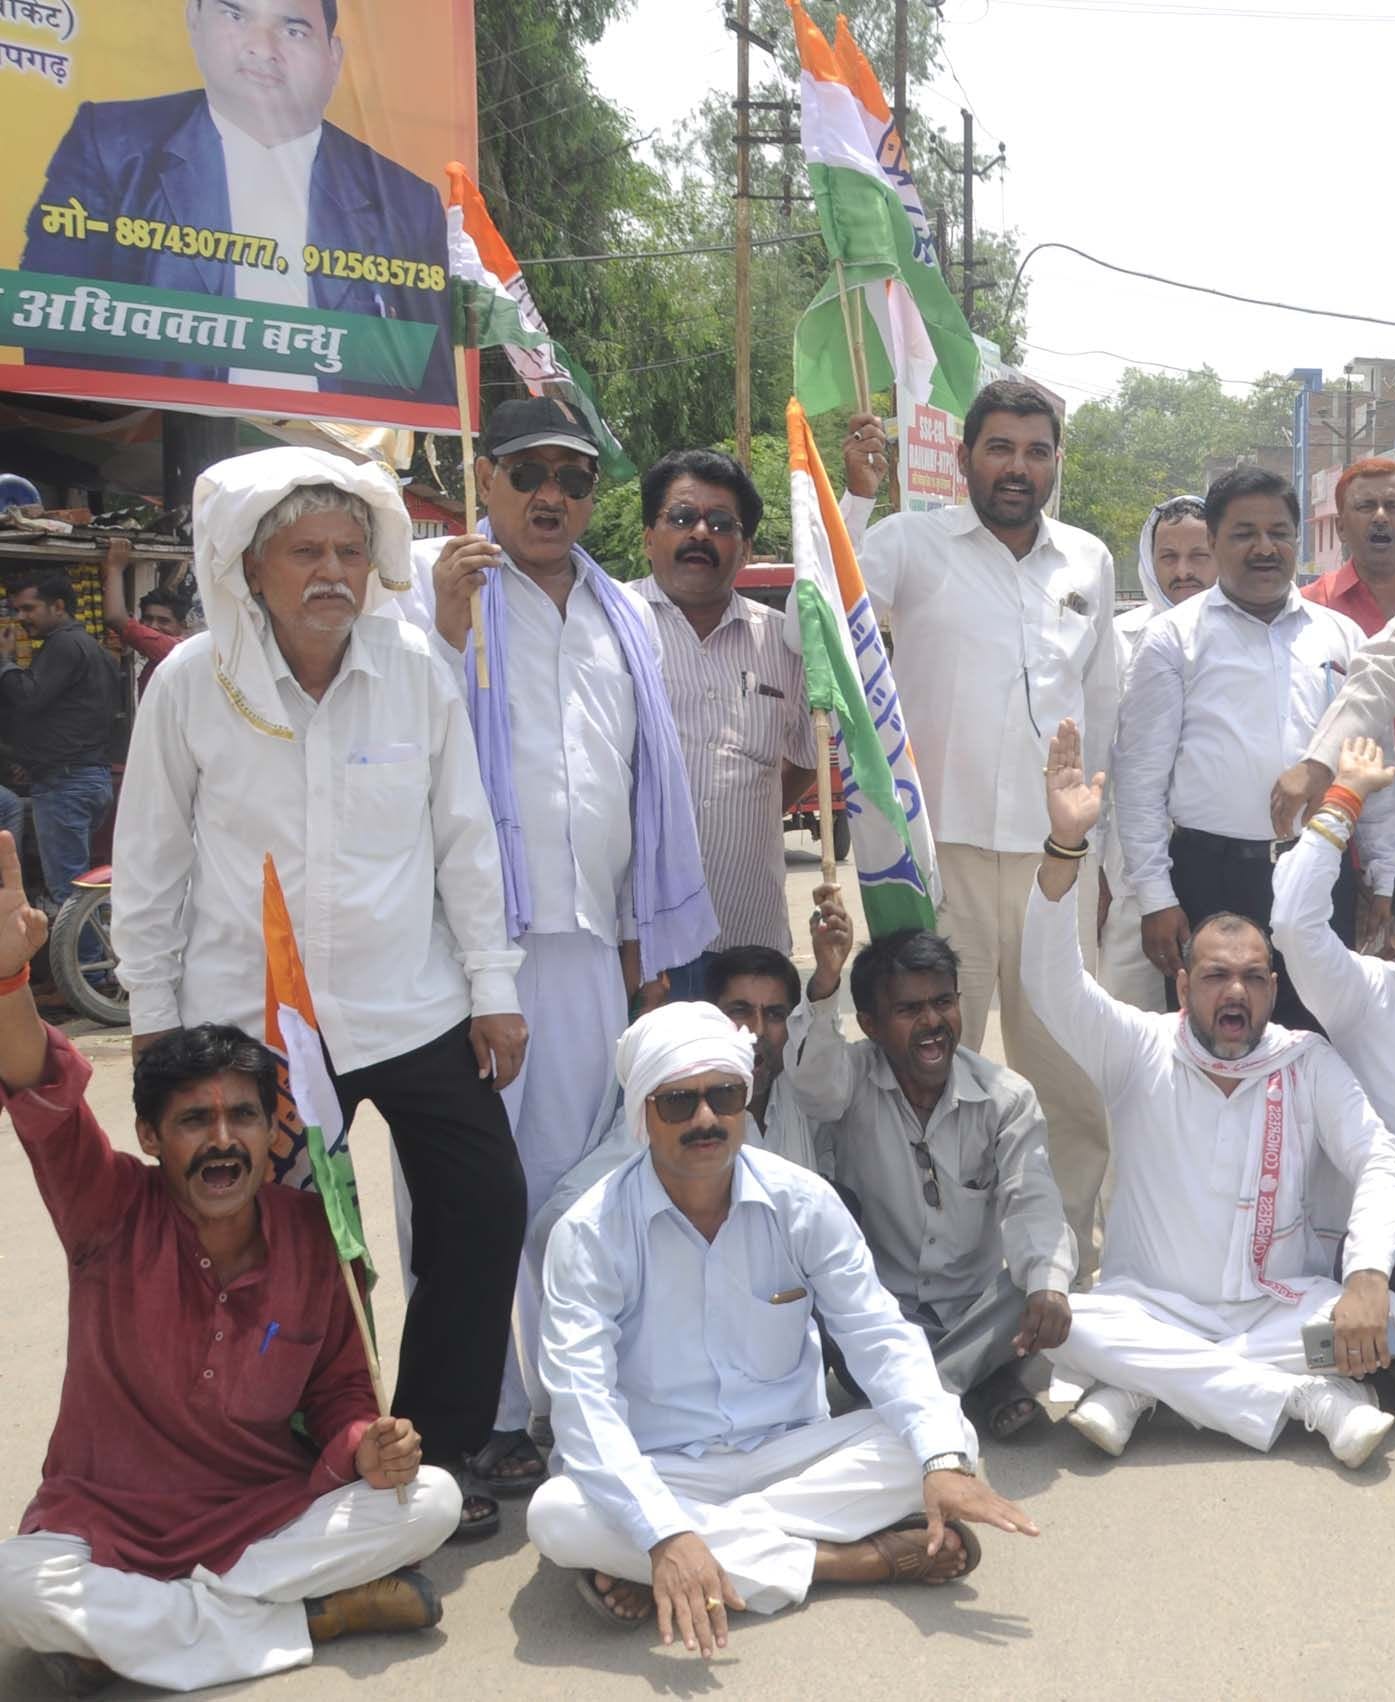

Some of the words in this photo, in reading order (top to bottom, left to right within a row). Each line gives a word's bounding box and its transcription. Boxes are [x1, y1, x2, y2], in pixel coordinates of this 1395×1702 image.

[115, 217, 289, 274] 8874307777,
[303, 245, 446, 291] 9125635738
[12, 286, 252, 350] अधिवक्ता
[262, 318, 347, 372] बन्धु
